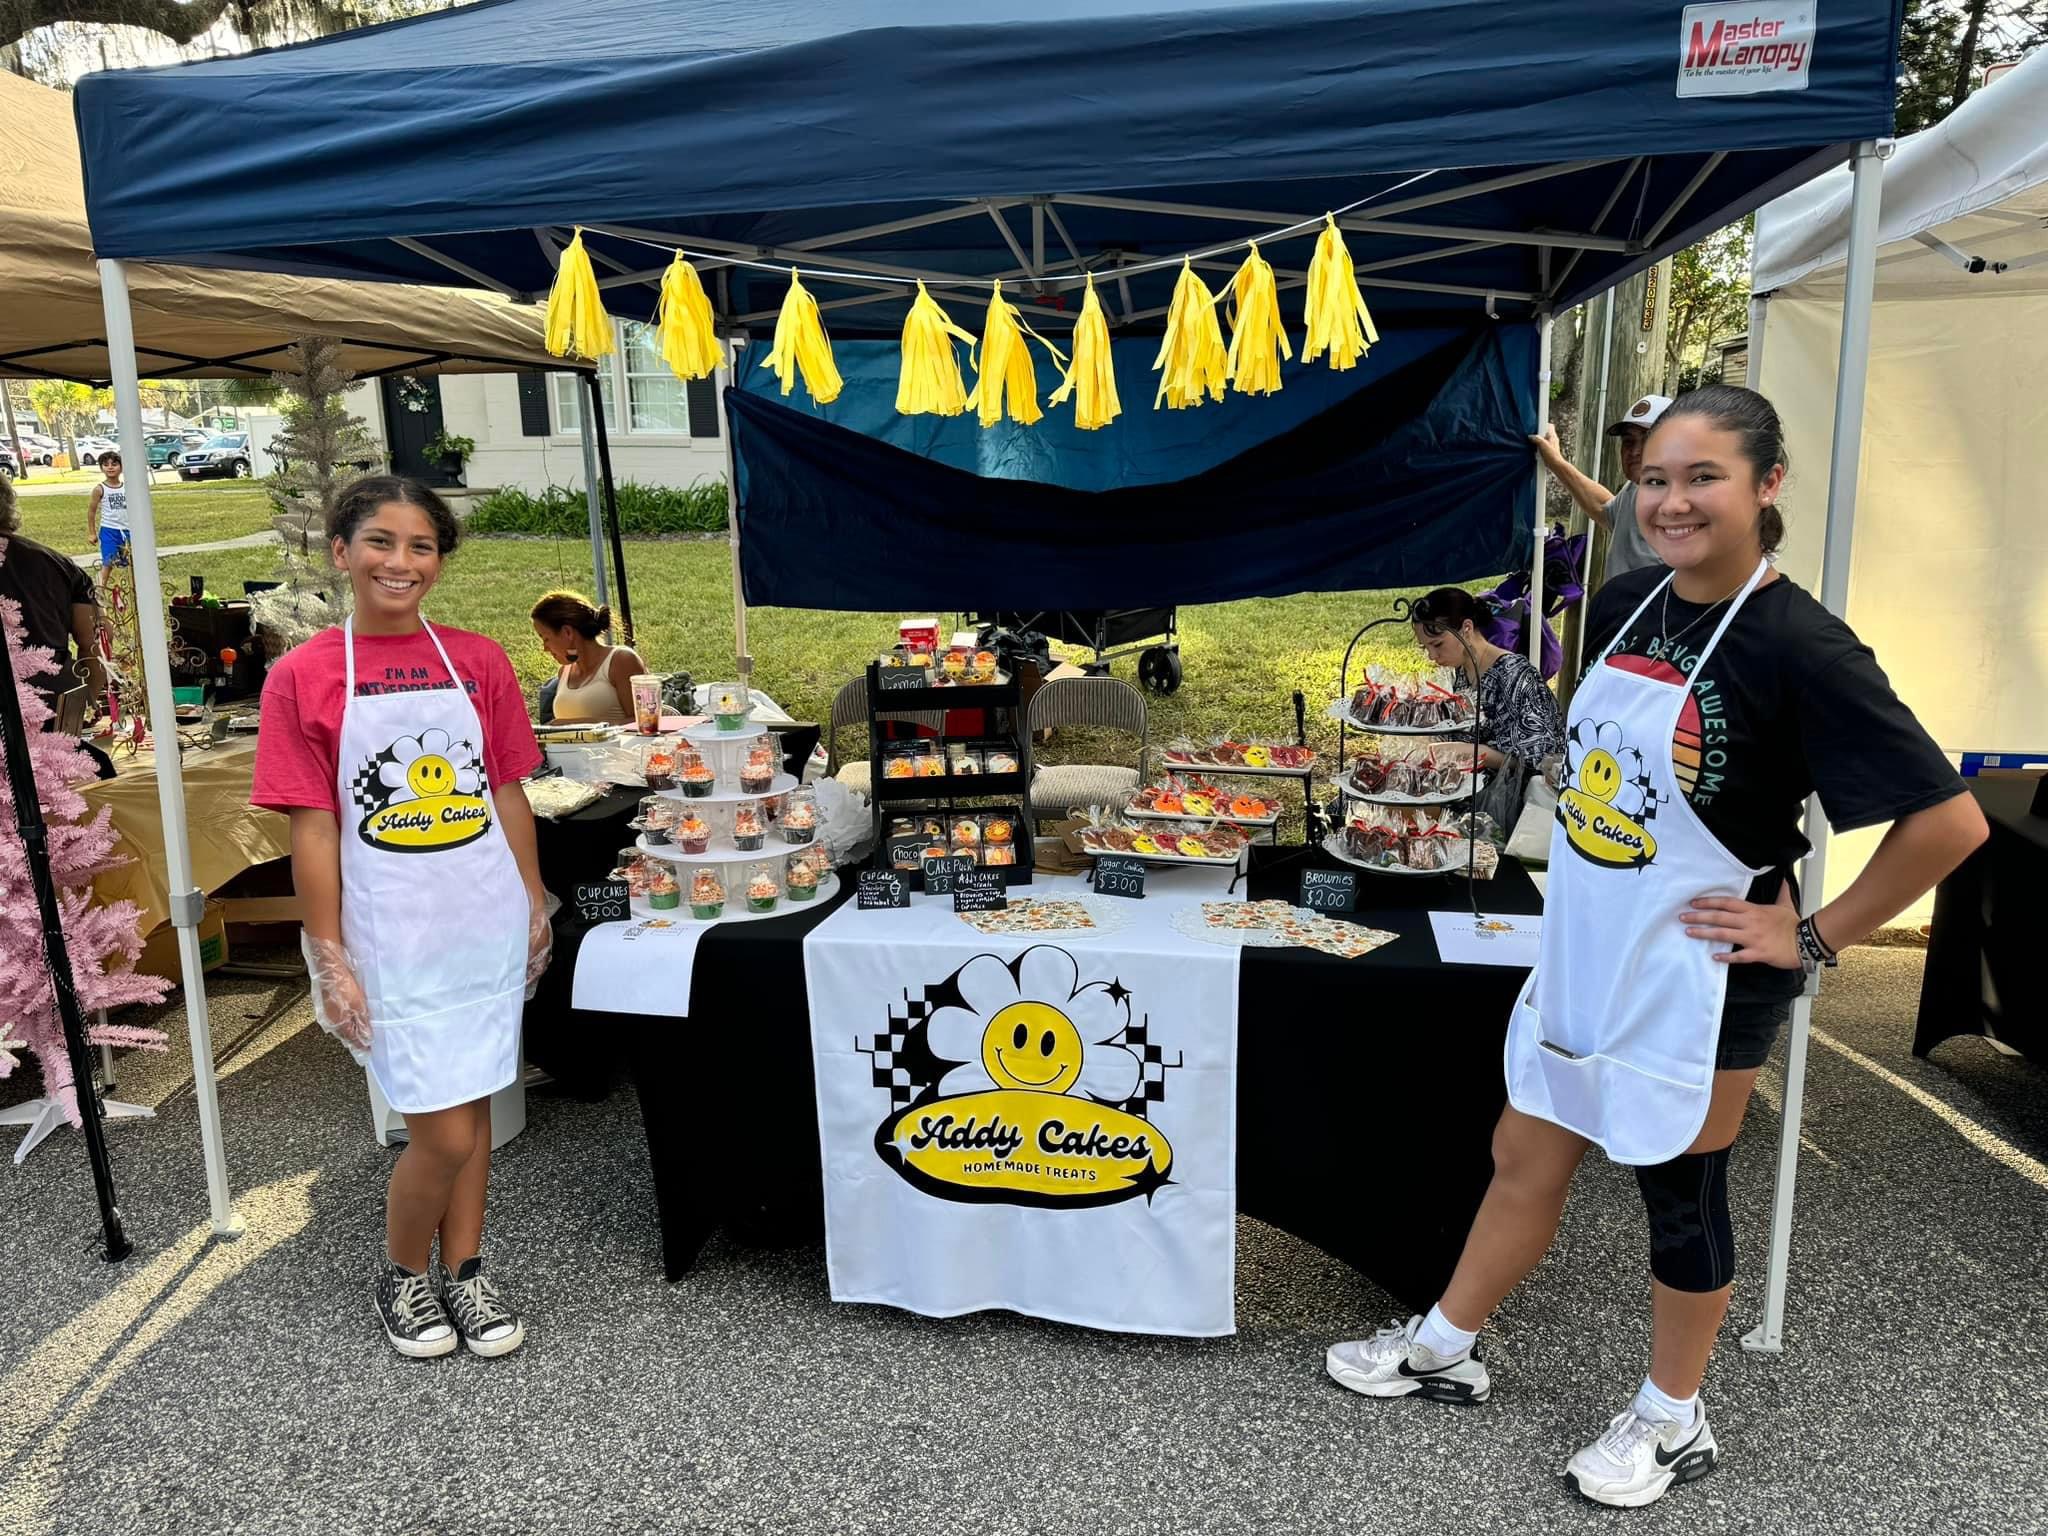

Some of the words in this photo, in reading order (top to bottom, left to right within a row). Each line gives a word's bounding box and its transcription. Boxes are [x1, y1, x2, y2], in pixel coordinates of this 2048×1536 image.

[1685, 17, 1784, 68] Master
[1721, 42, 1807, 71] Canopy
[1696, 68, 1702, 76] be
[1704, 68, 1713, 76] the
[1747, 68, 1760, 76] your
[1763, 65, 1772, 74] life
[385, 667, 406, 679] I'M
[411, 667, 429, 679] AN
[1694, 679, 1728, 806] AWESOME
[377, 811, 434, 832] Addy
[441, 805, 487, 824] Cakes
[1593, 815, 1644, 849] Cakes
[1306, 889, 1346, 907] $2.00
[581, 905, 621, 920] $3.00
[910, 1115, 1023, 1158] Addy
[1038, 1119, 1152, 1159] Cakes
[963, 1160, 1041, 1174] HOMEMADE
[1046, 1166, 1097, 1180] TREATS
